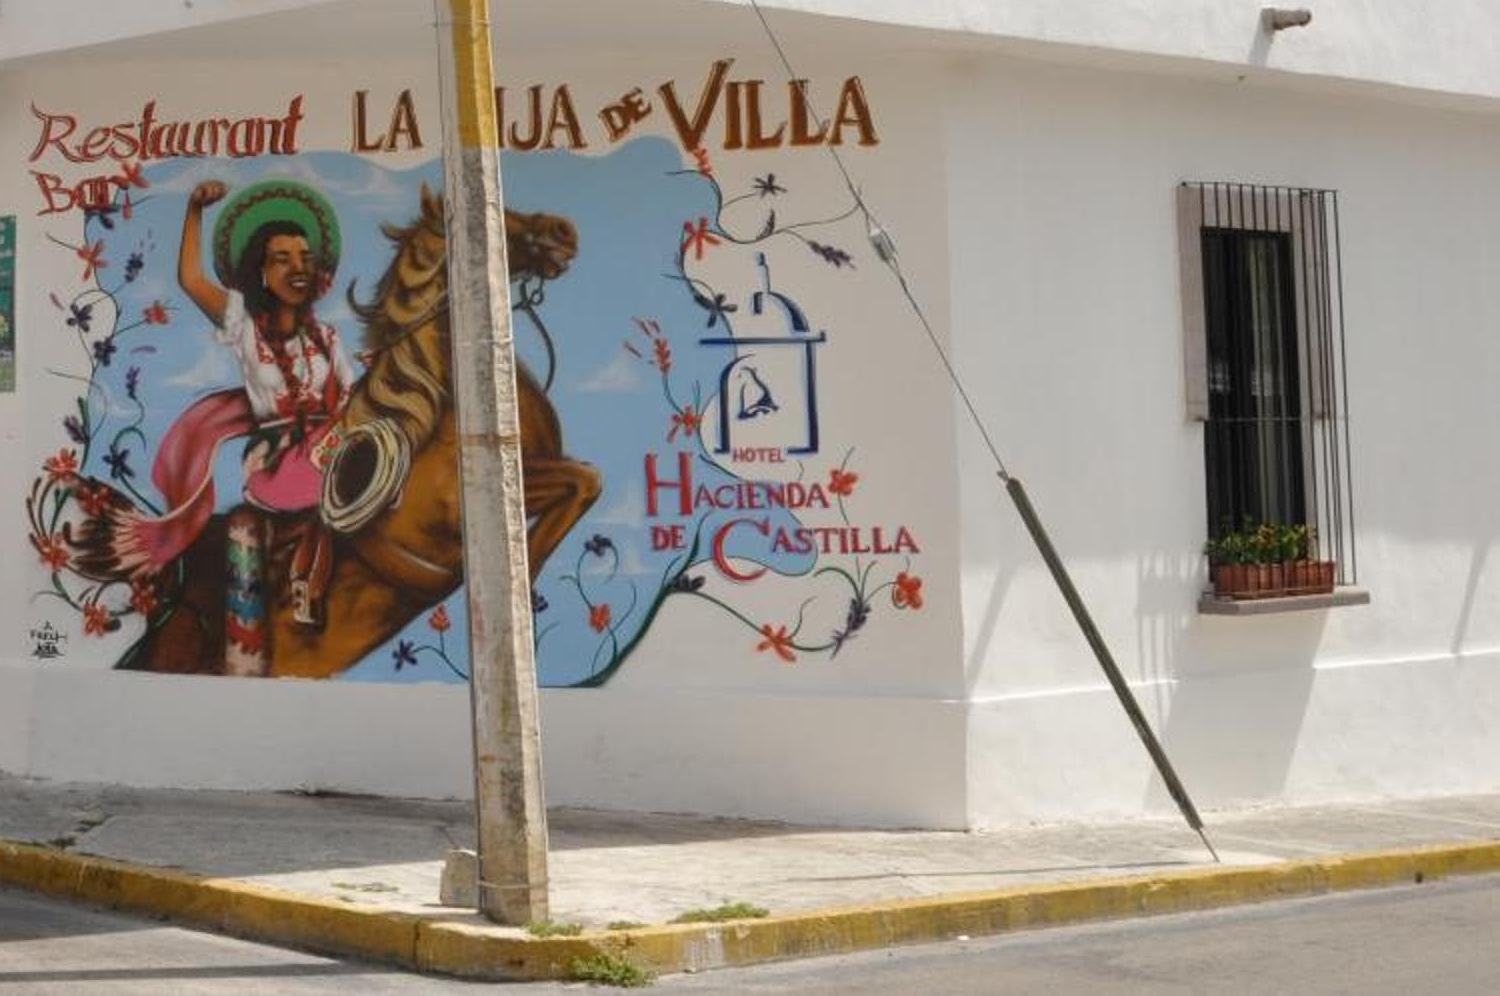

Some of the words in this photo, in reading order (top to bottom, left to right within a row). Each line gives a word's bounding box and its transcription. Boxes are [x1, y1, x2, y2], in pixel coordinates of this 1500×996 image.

[28, 92, 305, 164] Restaurant
[350, 87, 425, 154] LA
[495, 82, 589, 152] IJA
[597, 85, 654, 144] DE
[657, 57, 882, 152] VILLA
[644, 450, 831, 518] HACIENDA
[732, 446, 786, 464] HOTEL
[650, 524, 688, 552] DE
[711, 516, 921, 583] CASTILLA
